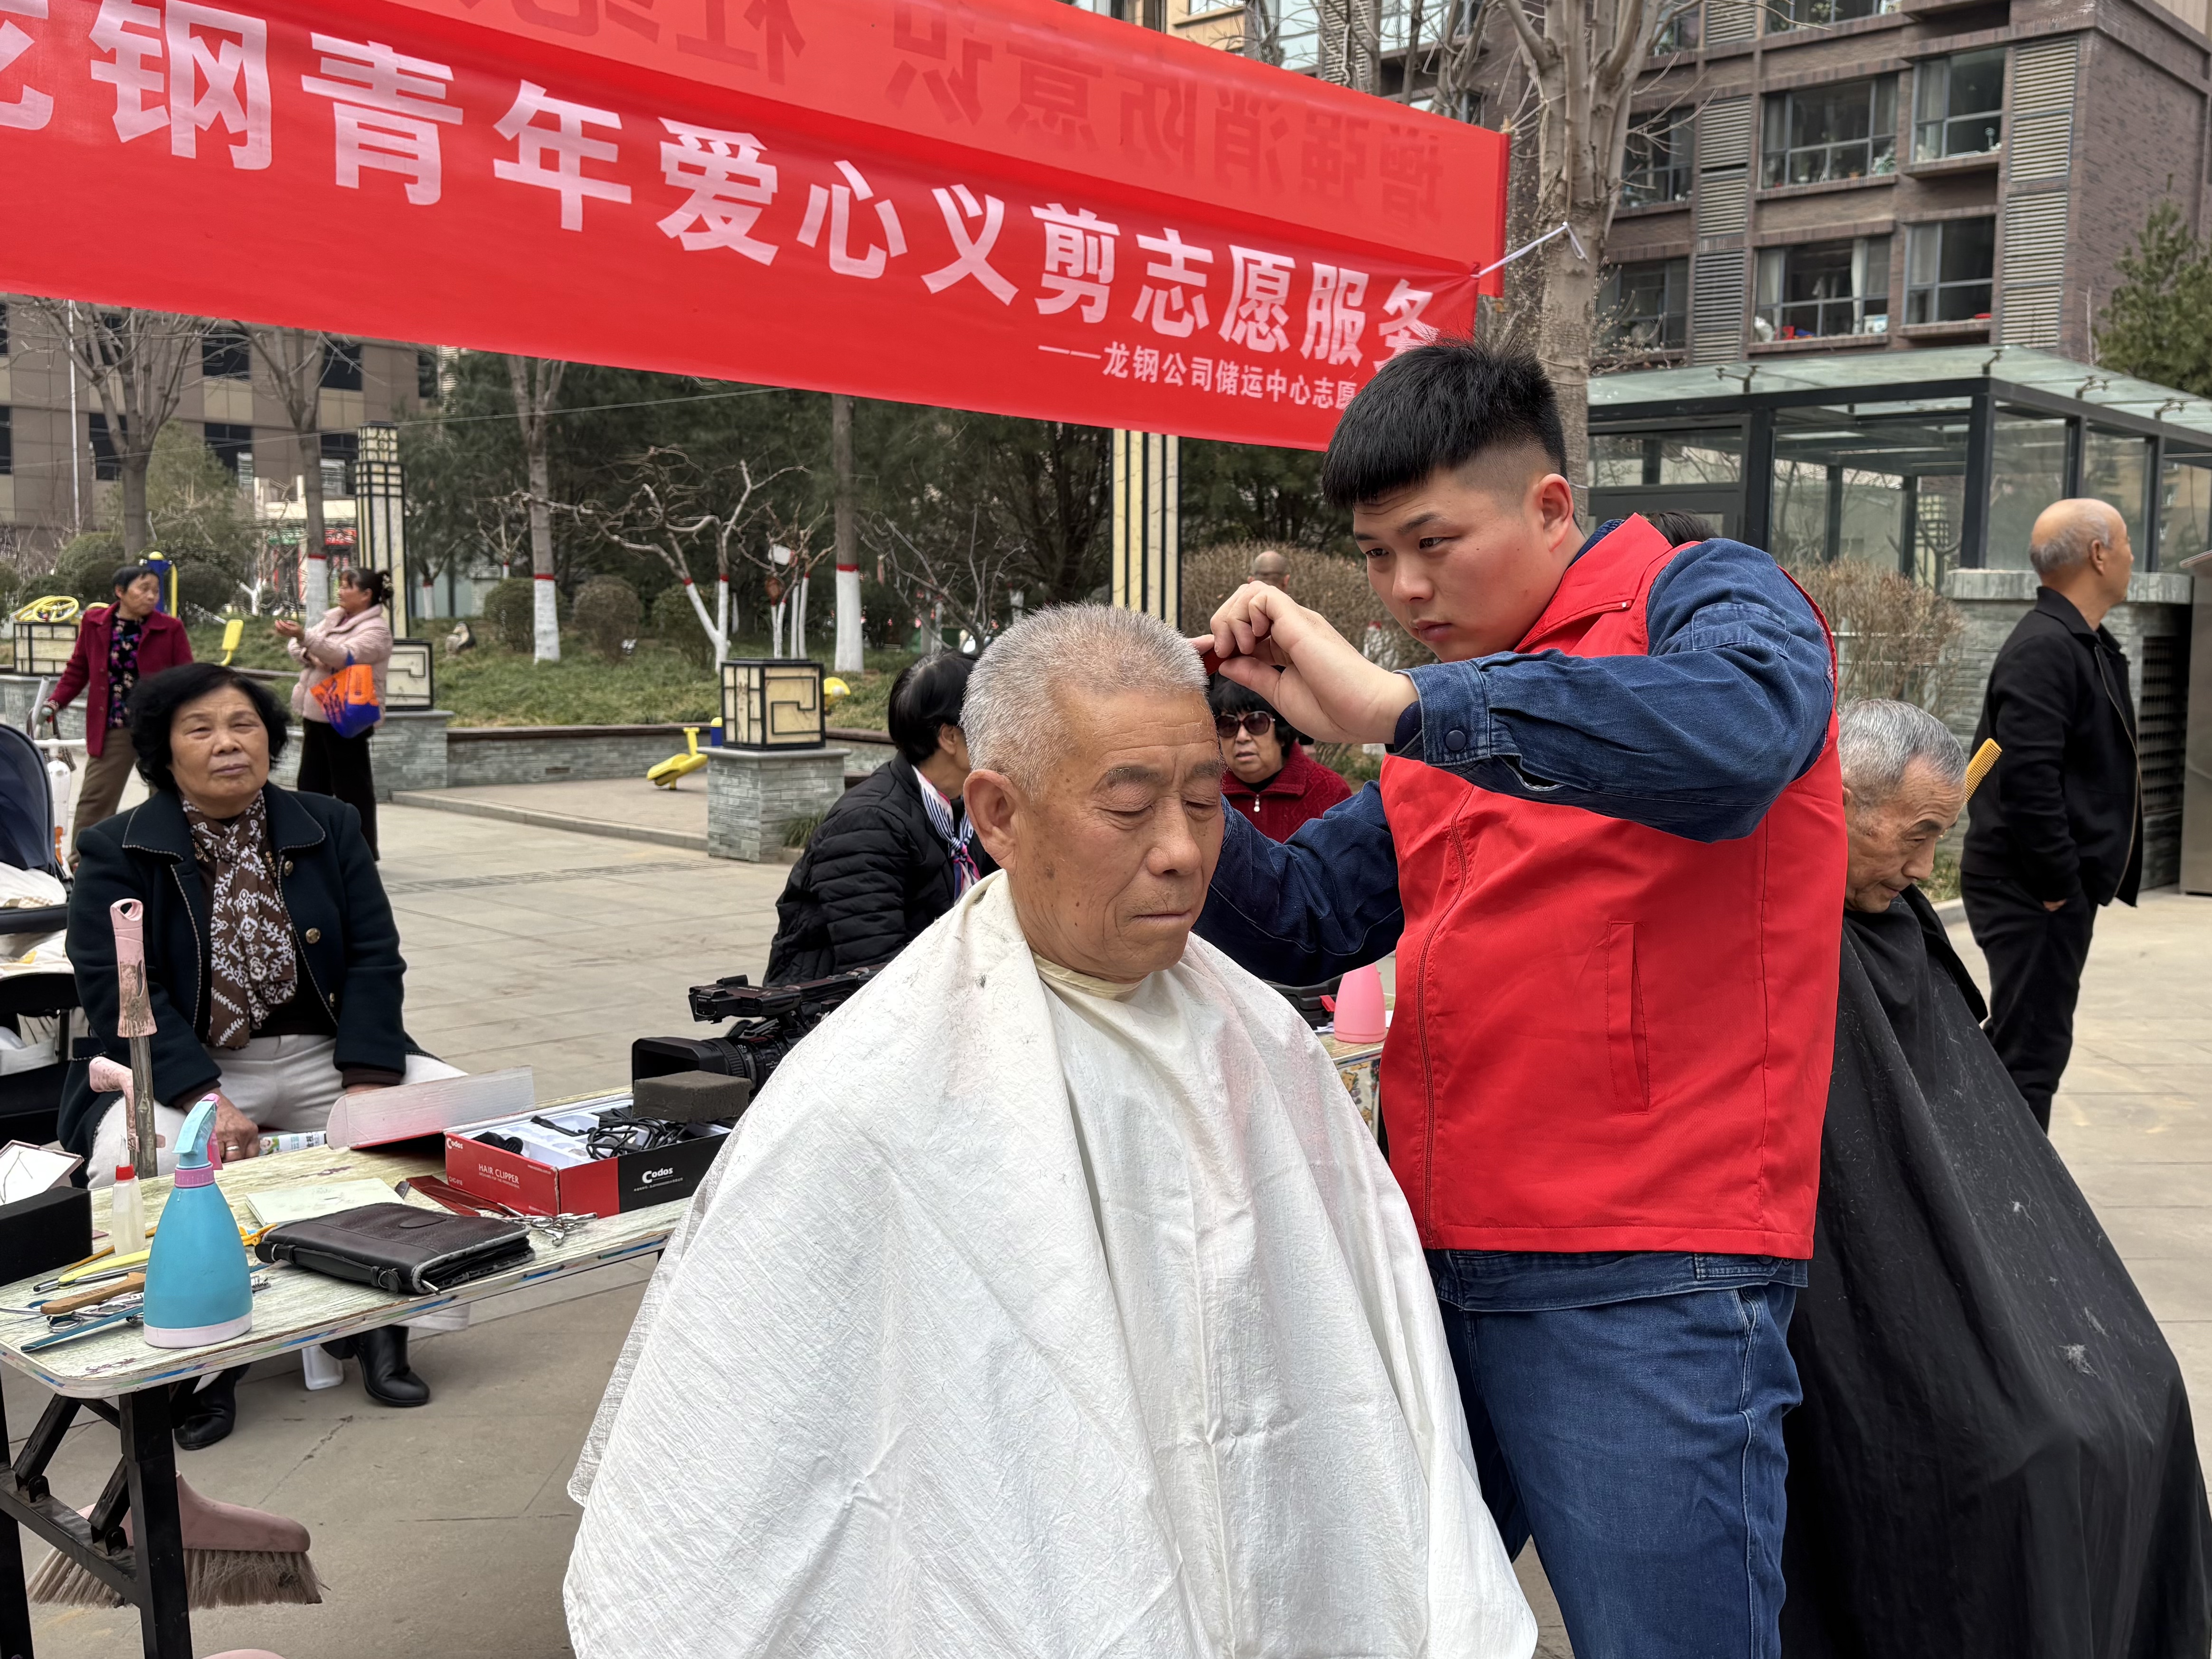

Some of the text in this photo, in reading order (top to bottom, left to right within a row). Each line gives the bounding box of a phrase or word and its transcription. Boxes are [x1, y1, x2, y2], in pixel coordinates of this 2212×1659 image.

[479, 1163, 494, 1176] HAIR
[495, 1169, 520, 1184] CLIPPER
[642, 1168, 673, 1184] Codos
